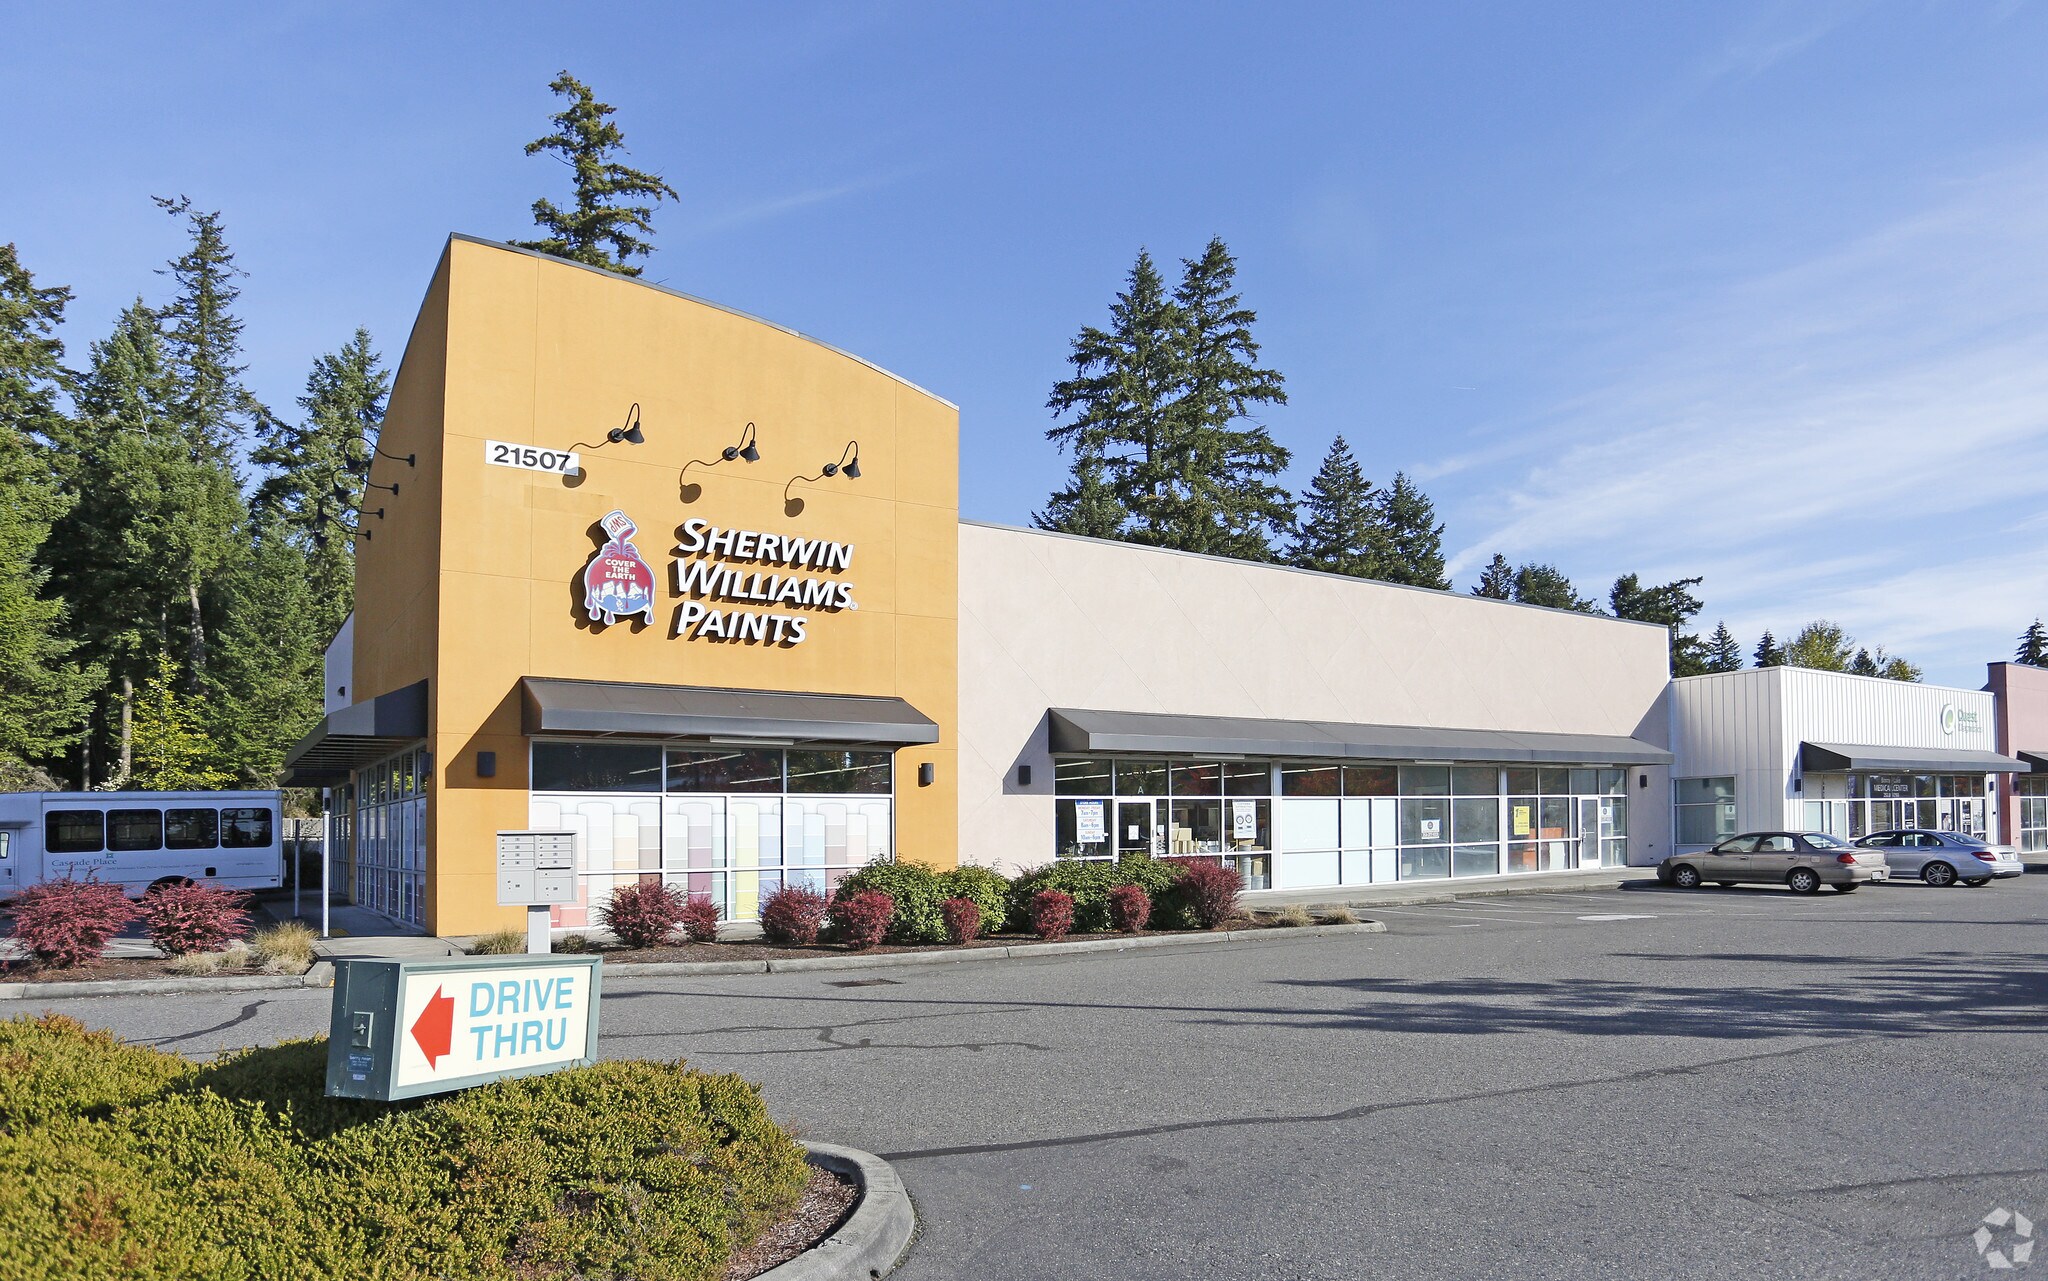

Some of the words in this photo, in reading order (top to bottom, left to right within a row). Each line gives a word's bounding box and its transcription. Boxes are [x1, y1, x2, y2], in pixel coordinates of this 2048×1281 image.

[493, 444, 571, 471] 21507
[610, 516, 627, 533] SWP
[678, 517, 855, 569] SHERWIN
[605, 559, 636, 568] COVER
[612, 565, 630, 574] THE
[605, 572, 636, 580] EARTH
[676, 557, 854, 608] WILLIAMS
[676, 600, 809, 644] PAINTS
[1957, 709, 1977, 722] Quest
[1137, 785, 1144, 794] A
[93, 857, 117, 866] Place
[469, 976, 574, 1018] DRIVE
[469, 1017, 567, 1061] THRU
